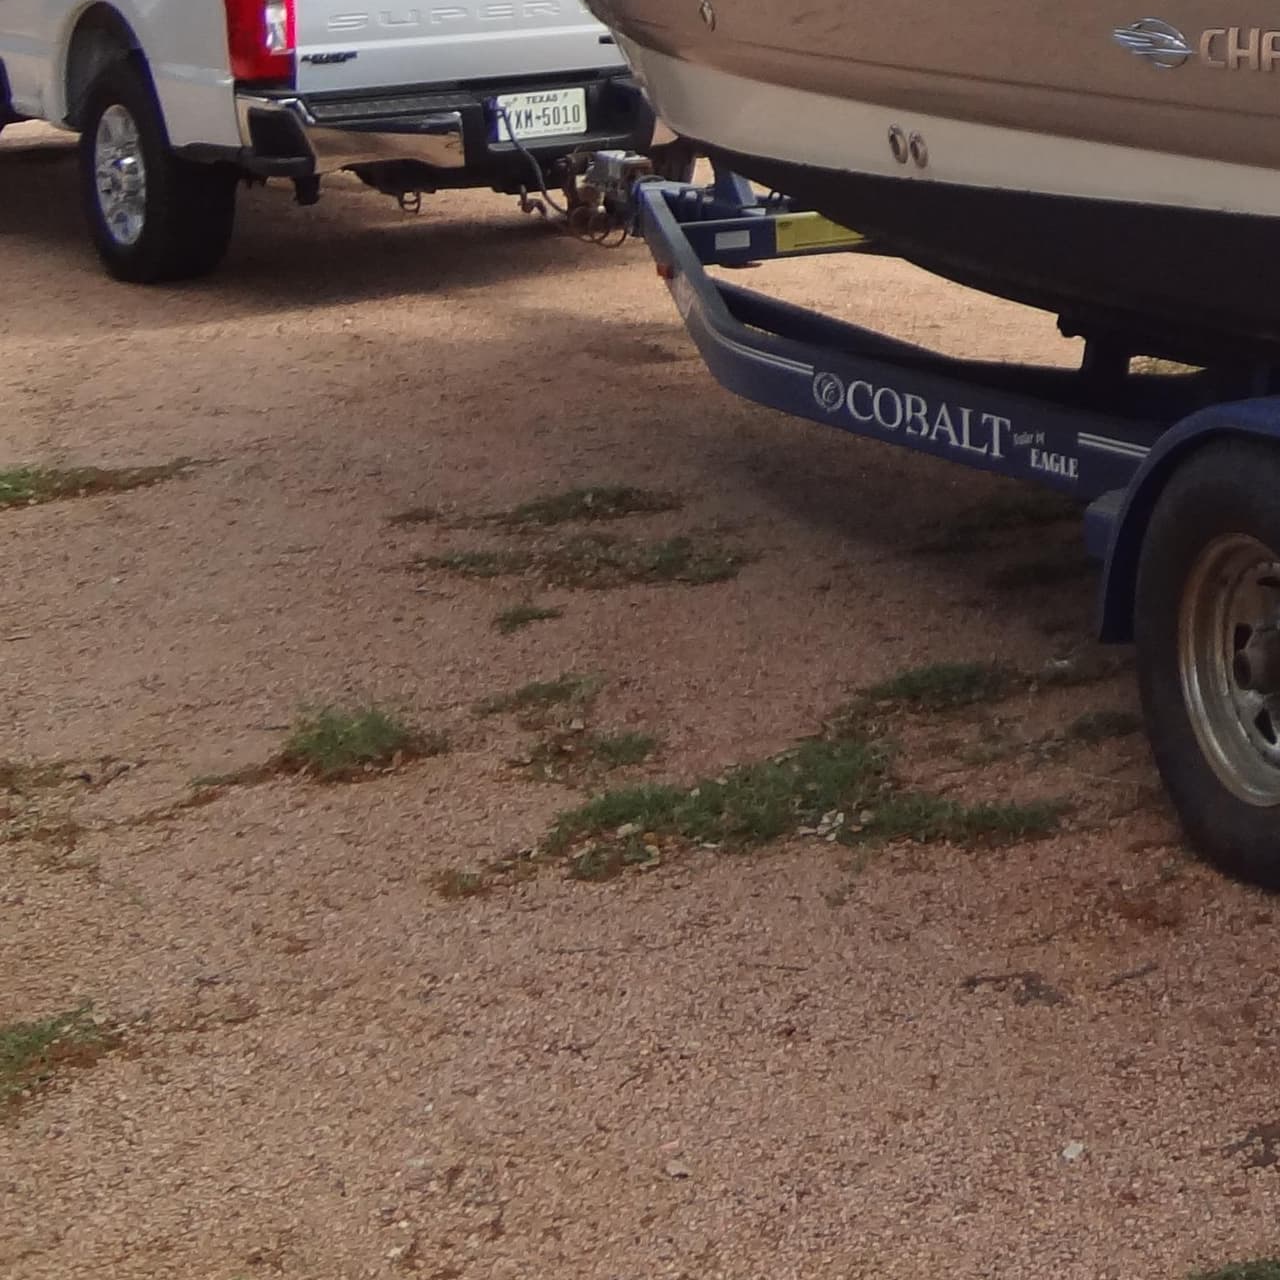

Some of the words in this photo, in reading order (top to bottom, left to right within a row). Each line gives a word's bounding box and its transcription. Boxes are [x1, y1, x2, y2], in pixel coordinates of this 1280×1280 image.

[327, 0, 561, 33] SUPER
[525, 93, 558, 105] TEXAS
[846, 379, 1011, 459] COBALT
[1030, 447, 1079, 479] EAGLE
